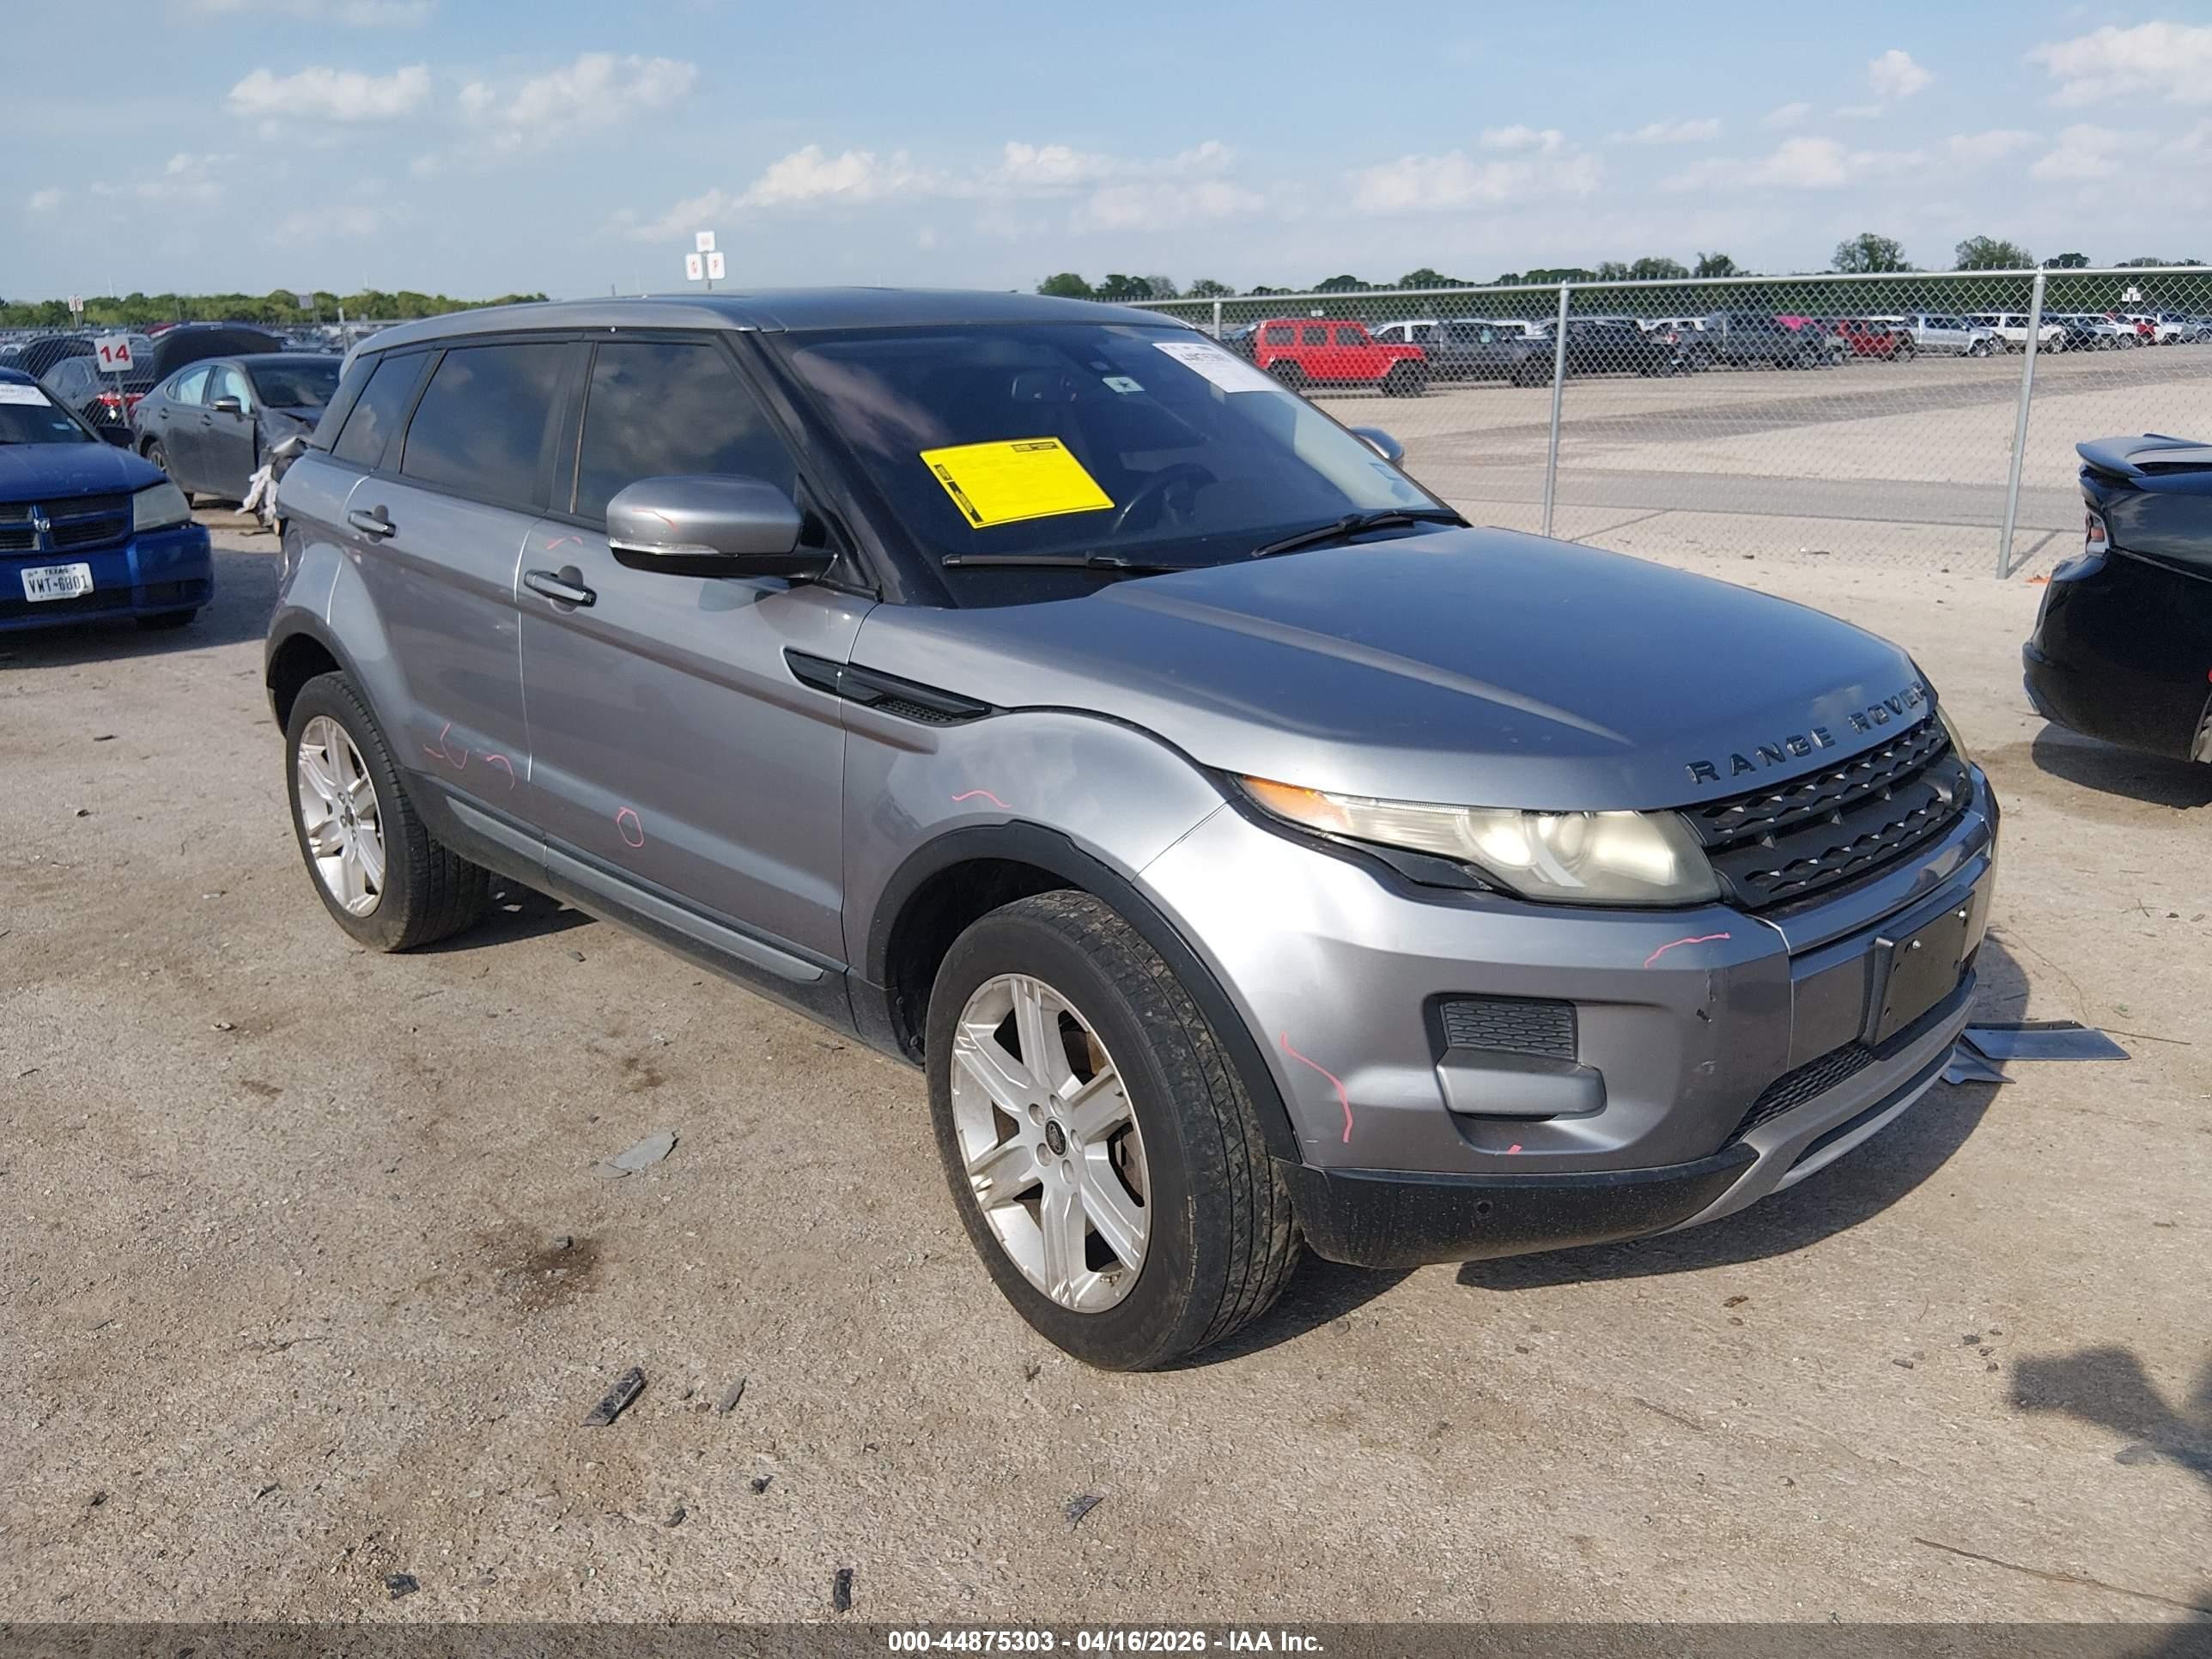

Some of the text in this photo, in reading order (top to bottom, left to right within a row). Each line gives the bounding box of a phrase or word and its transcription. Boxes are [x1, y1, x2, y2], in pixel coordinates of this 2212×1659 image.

[100, 344, 130, 362] 14
[44, 568, 69, 576] TEXAS
[1685, 680, 1925, 785] RANGE ROVER
